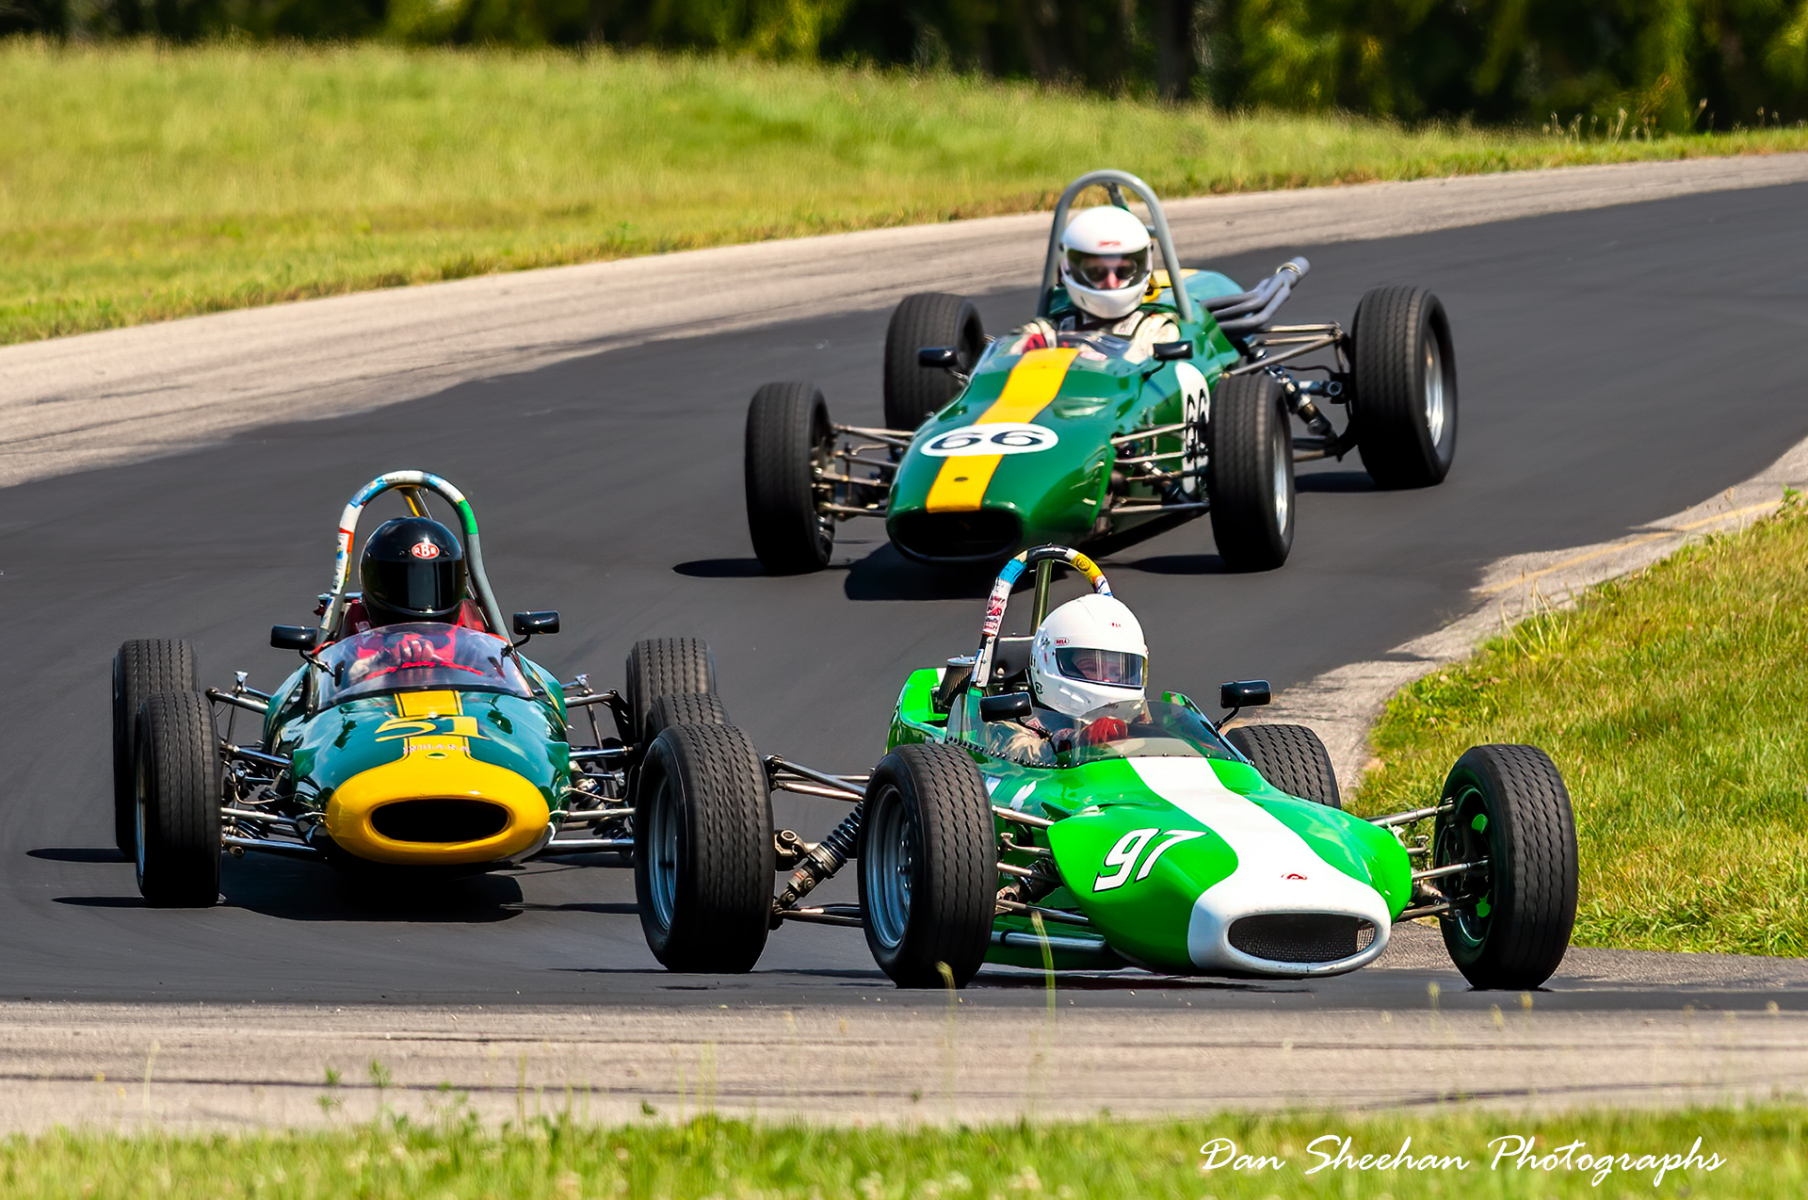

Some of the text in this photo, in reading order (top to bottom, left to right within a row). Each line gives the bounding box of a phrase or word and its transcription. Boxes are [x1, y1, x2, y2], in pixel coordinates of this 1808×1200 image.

[930, 430, 1045, 450] 66
[375, 715, 491, 742] 51
[1092, 828, 1209, 893] 97
